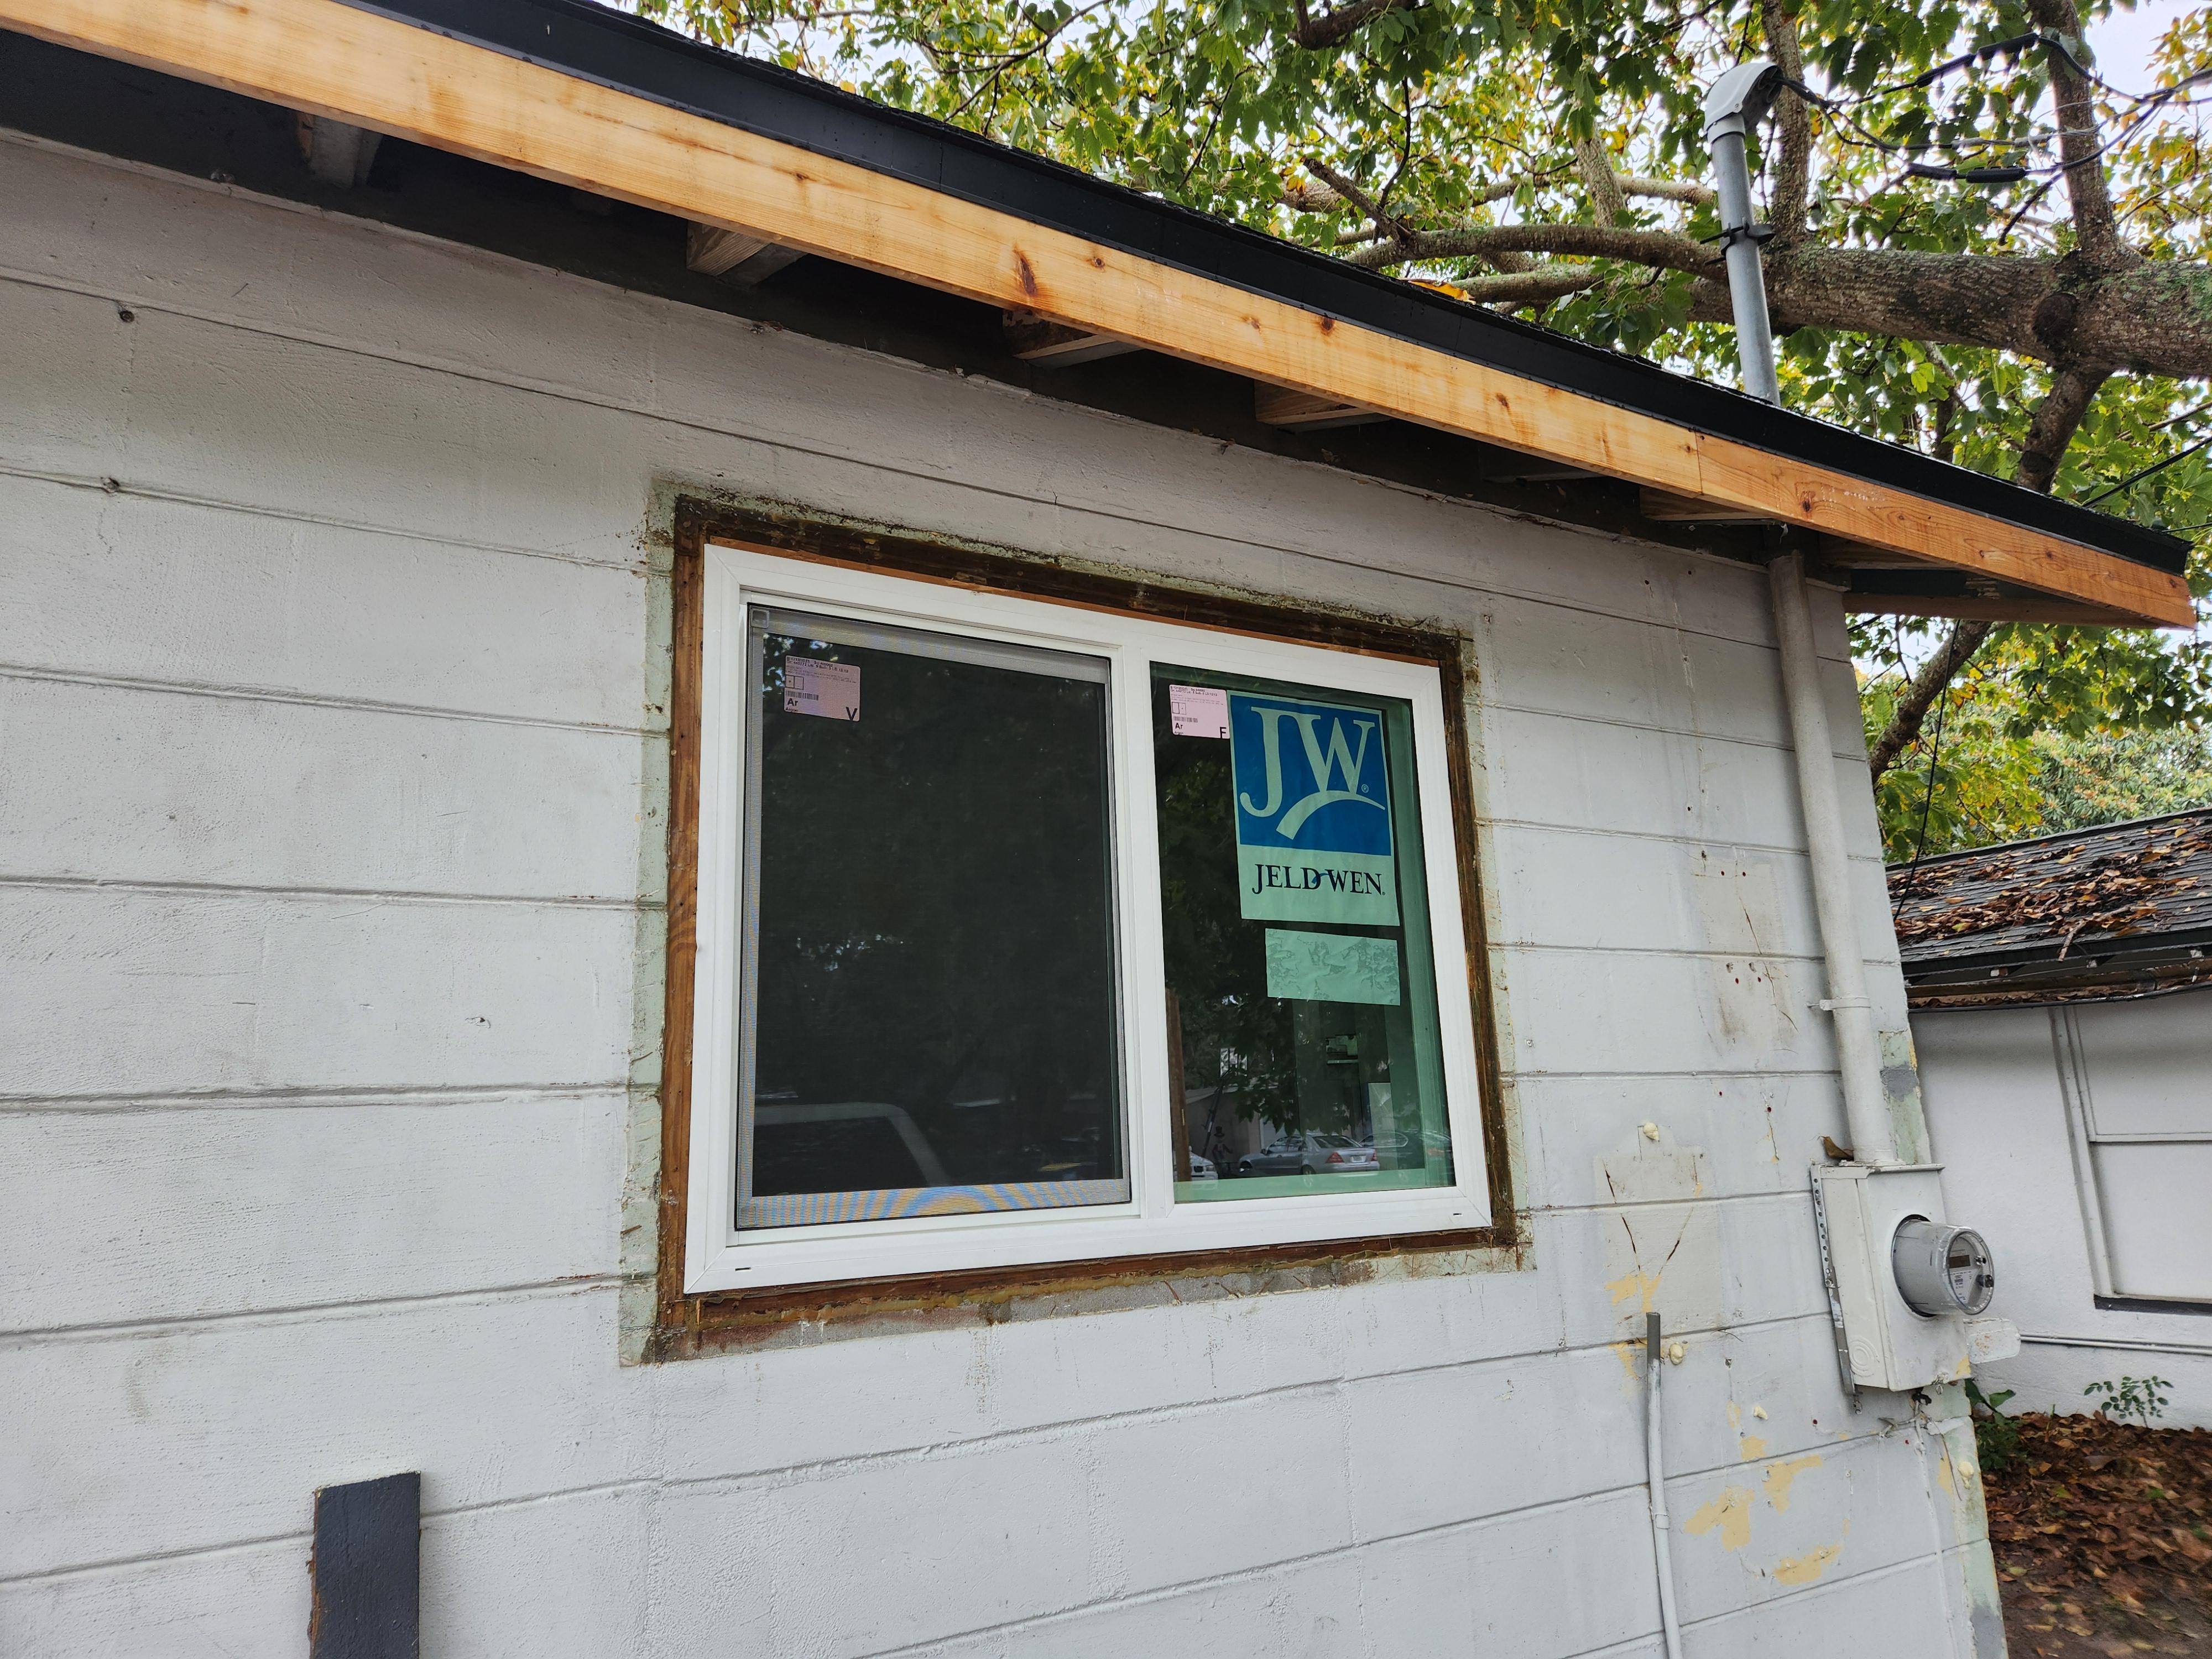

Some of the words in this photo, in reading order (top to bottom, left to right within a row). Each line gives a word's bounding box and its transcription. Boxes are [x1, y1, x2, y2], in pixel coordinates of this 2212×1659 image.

[787, 698, 799, 706] Ar
[846, 706, 858, 721] V
[1219, 727, 1227, 738] F
[1240, 706, 1375, 817] JW
